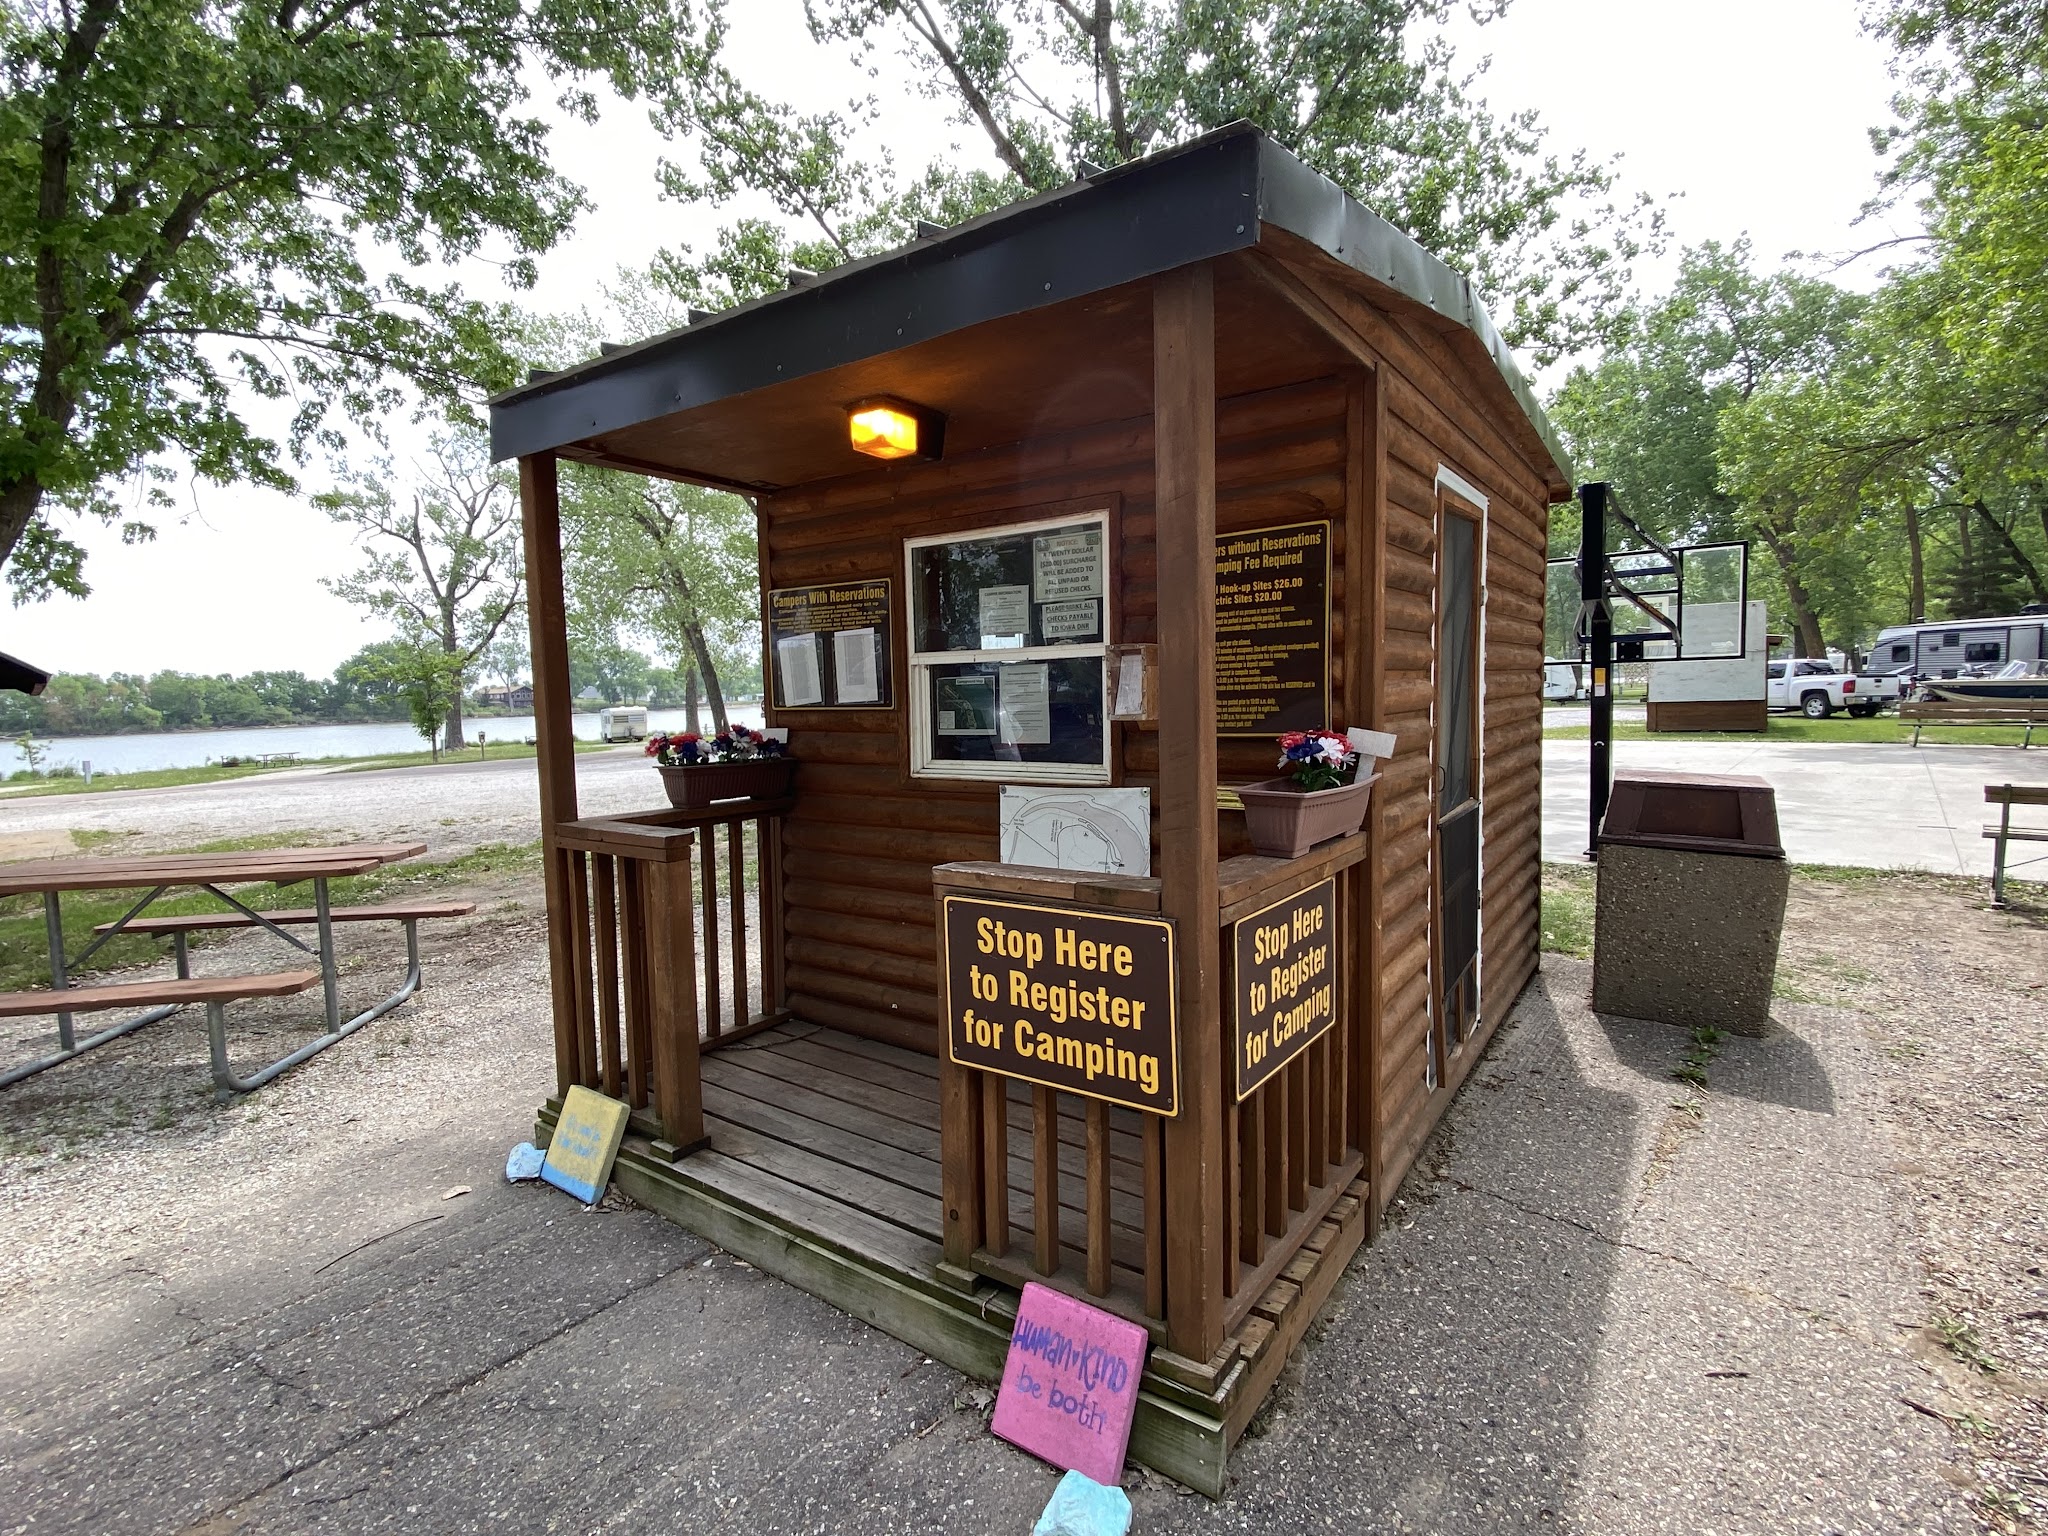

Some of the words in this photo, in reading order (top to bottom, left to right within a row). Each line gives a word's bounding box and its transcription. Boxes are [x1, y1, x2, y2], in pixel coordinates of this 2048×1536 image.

[1072, 546, 1094, 554] DOLLAR
[1228, 539, 1260, 556] without
[1262, 532, 1321, 551] Reservations
[1063, 556, 1096, 566] SURCHARGE
[1216, 558, 1242, 575] mping
[1244, 556, 1260, 570] Fee
[1262, 550, 1302, 570] Required
[774, 595, 807, 609] Campers
[808, 590, 828, 604] With
[830, 586, 885, 602] Reservations
[1216, 596, 1232, 606] ctric
[1234, 594, 1252, 604] Sites
[1254, 590, 1282, 602] $20.00
[1220, 583, 1250, 594] Hook-up
[1252, 580, 1272, 591] Sites
[1274, 578, 1302, 590] $26.00
[1069, 612, 1094, 620] PAYABLE
[977, 917, 1043, 969] Stop
[1055, 928, 1133, 976] Here
[1254, 922, 1288, 965] Stop
[1292, 904, 1323, 944] Here
[1250, 982, 1266, 1016] to
[1271, 944, 1327, 1003] Register
[970, 965, 998, 1002] to
[1009, 970, 1146, 1030] Register
[1246, 1028, 1268, 1069] for
[1272, 983, 1330, 1048] Camping
[963, 1009, 1004, 1050] for
[1014, 1019, 1159, 1095] Camping
[1016, 1364, 1042, 1399] be
[1048, 1379, 1108, 1435] both
